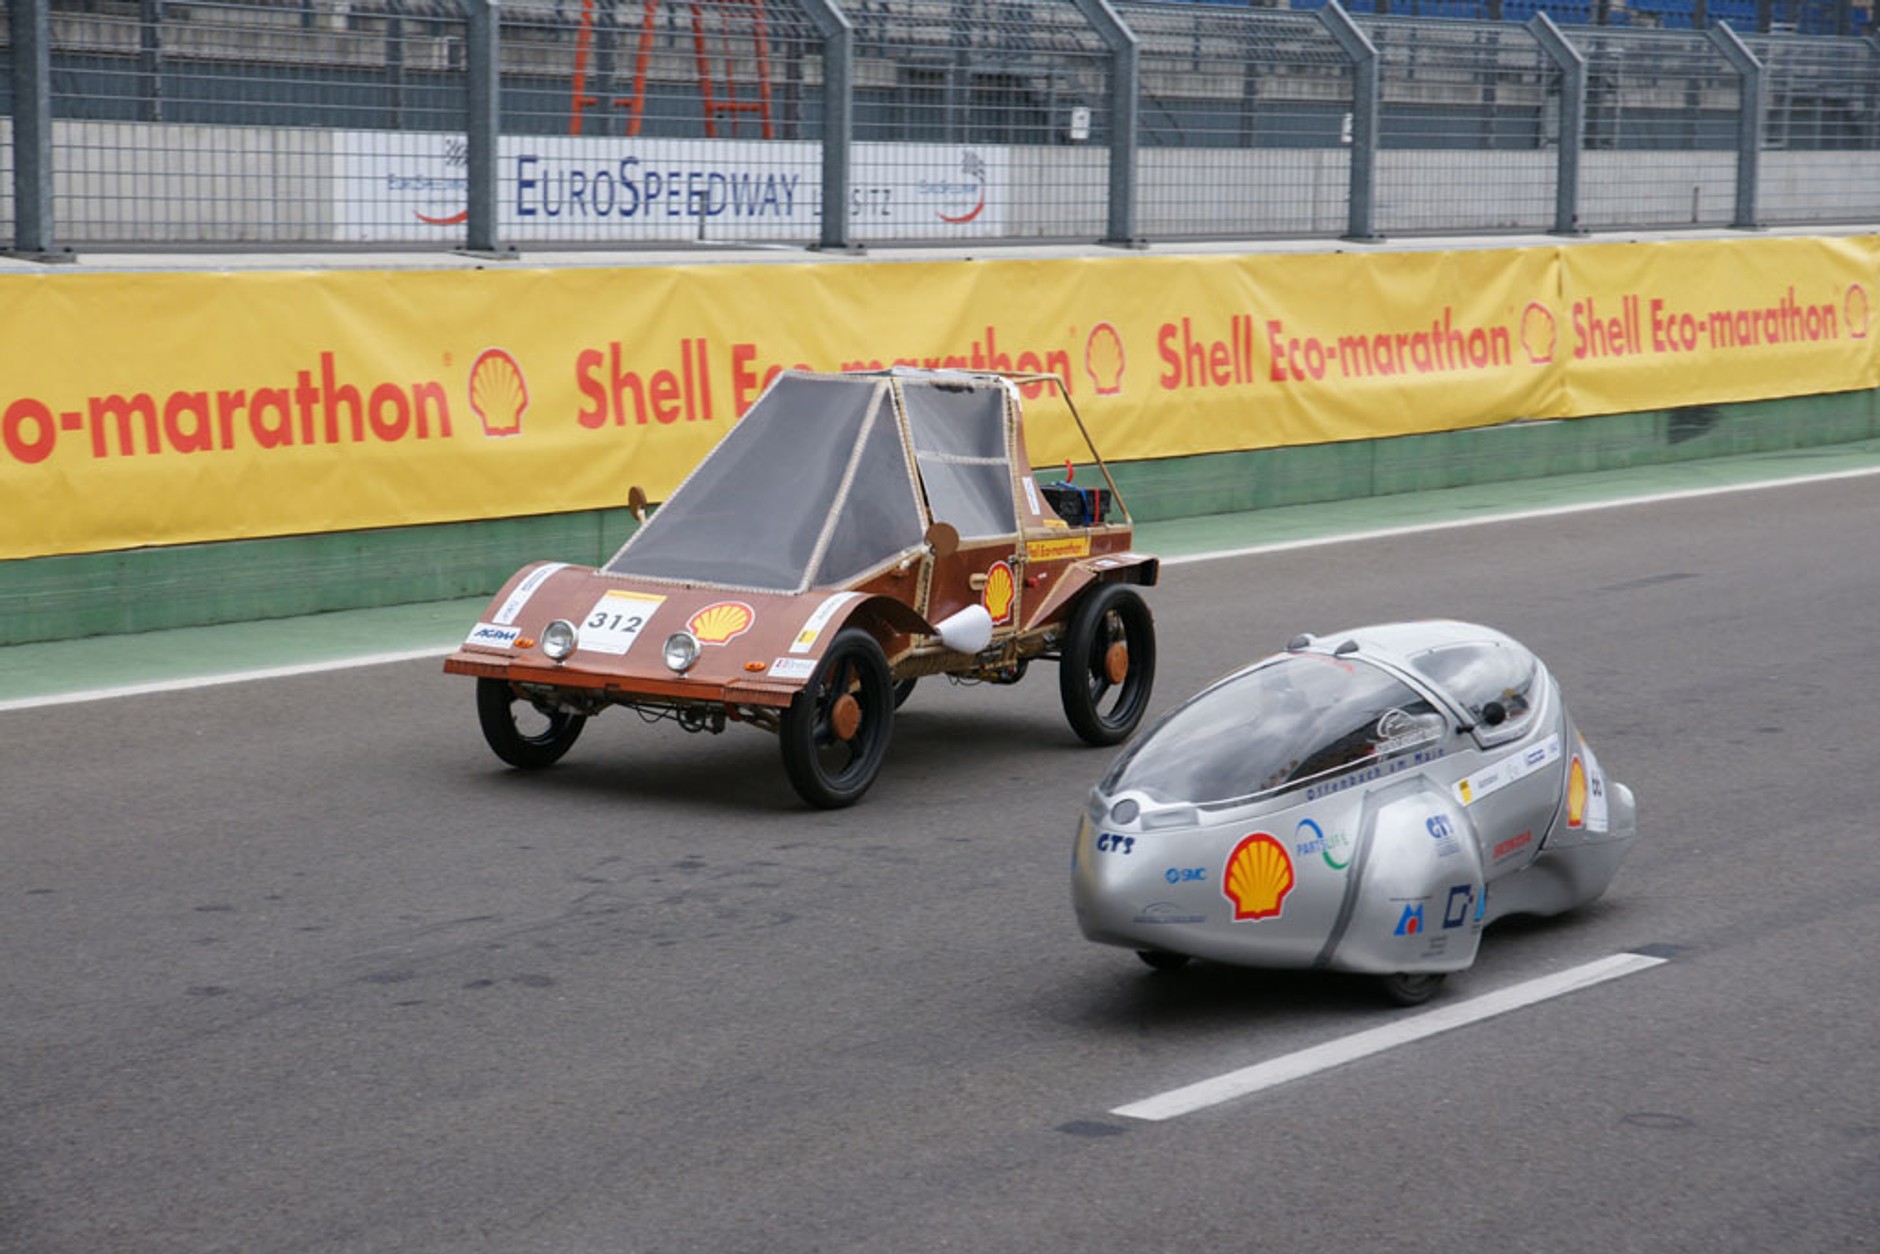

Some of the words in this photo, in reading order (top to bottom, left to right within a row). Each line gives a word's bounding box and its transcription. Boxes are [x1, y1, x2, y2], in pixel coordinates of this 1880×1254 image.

[1159, 315, 1253, 390] Shell
[1268, 307, 1511, 383] Eco-marathon
[1573, 295, 1641, 359] Shell
[1651, 286, 1838, 353] Eco-marathon
[576, 338, 713, 431] Shell
[588, 611, 643, 633] 312
